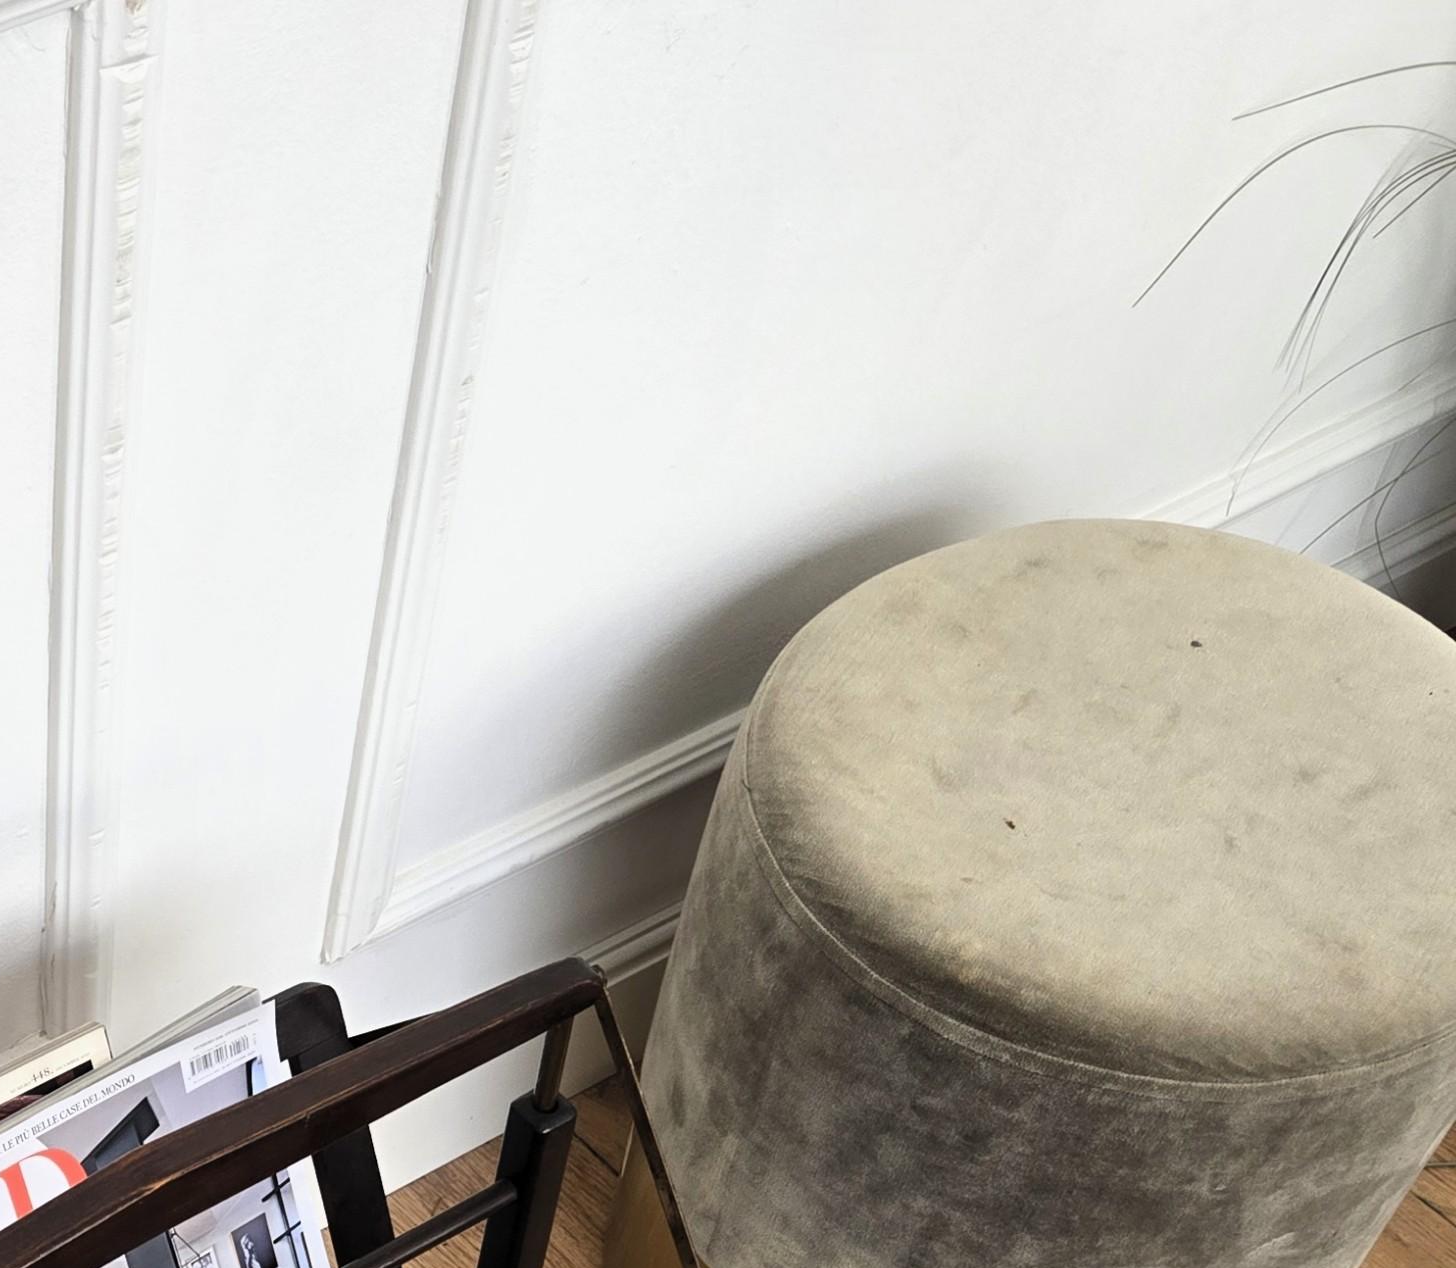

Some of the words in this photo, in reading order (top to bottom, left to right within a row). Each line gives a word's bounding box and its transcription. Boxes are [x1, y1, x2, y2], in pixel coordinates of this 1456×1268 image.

[1, 1142, 14, 1158] LE
[14, 1130, 31, 1150] PIÙ
[31, 1118, 60, 1141] BELLE
[60, 1105, 83, 1127] CASE
[83, 1093, 103, 1114] DEL
[101, 1074, 136, 1102] MONDO
